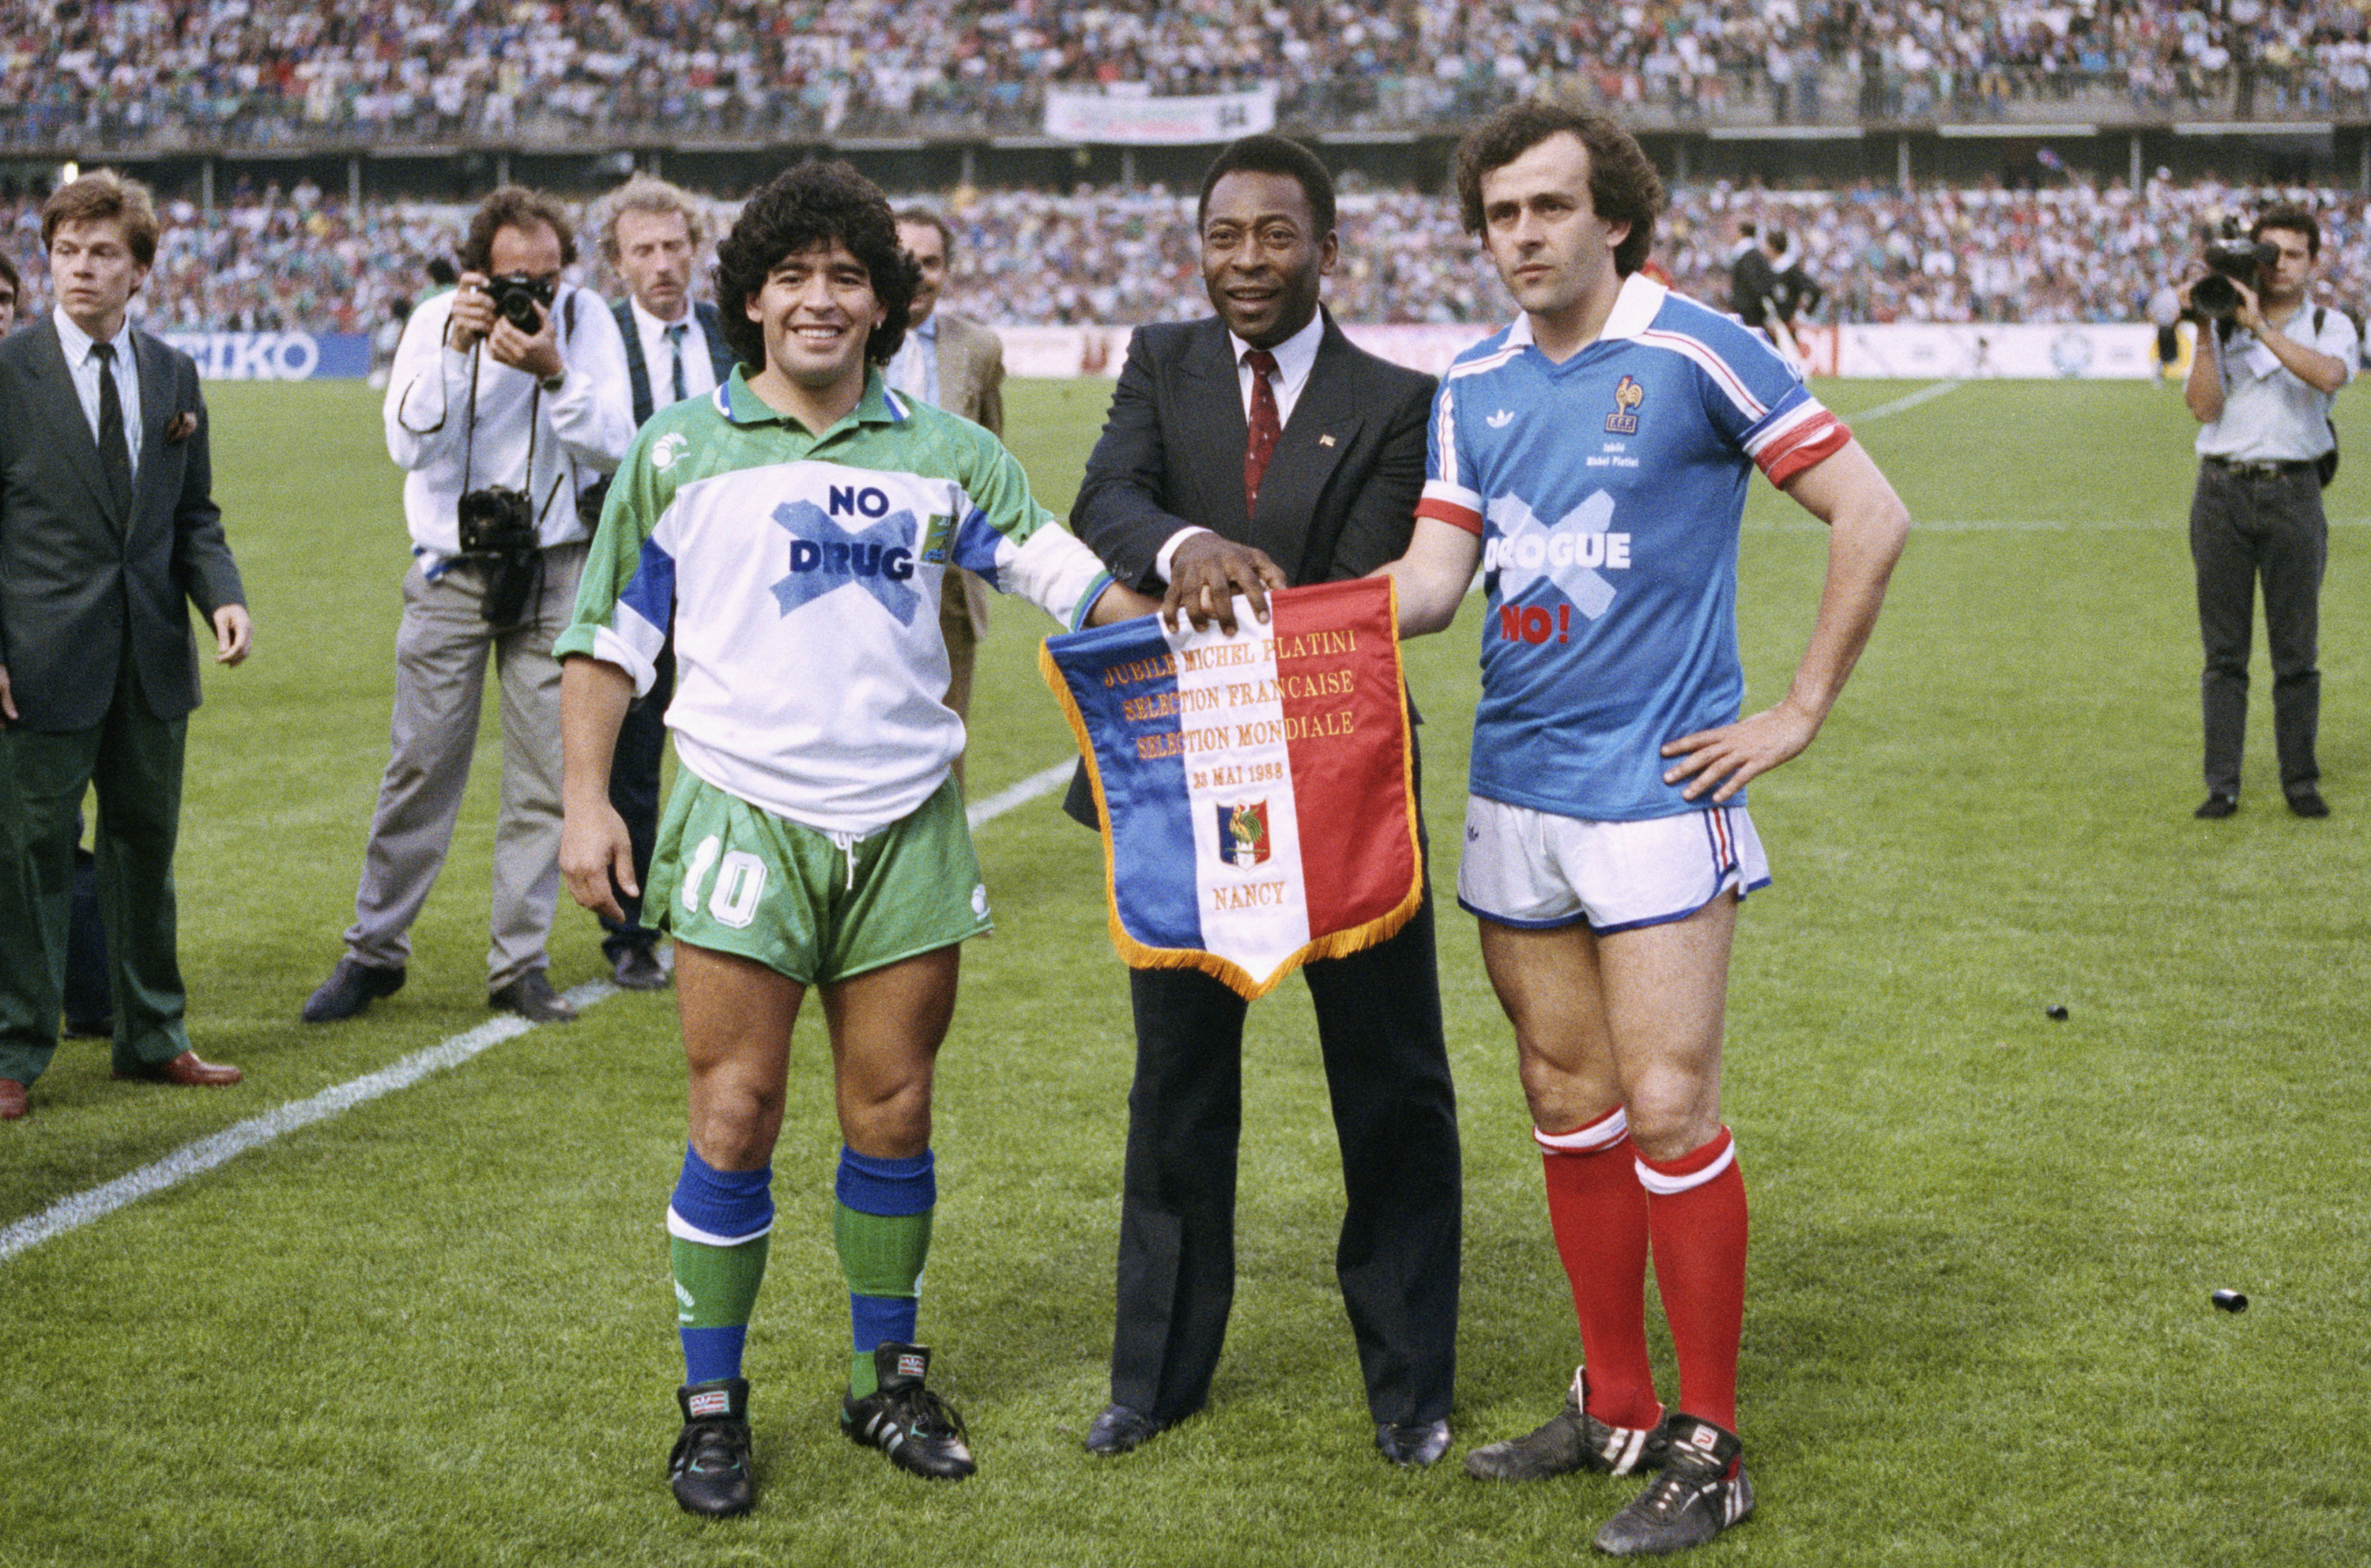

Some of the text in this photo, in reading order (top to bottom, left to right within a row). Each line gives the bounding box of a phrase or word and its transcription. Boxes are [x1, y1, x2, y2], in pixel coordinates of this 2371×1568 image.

[163, 331, 319, 381] EIKO
[829, 484, 890, 518] NO
[790, 540, 914, 581] DRUG
[1103, 630, 1357, 688] JUBILE MICHEL PLATINI
[1122, 670, 1355, 722] SELECTION FRANCAISE
[1136, 711, 1354, 760] SELECTION MONDIALE
[1212, 765, 1243, 786] MAI
[1248, 761, 1284, 782] 1988
[681, 835, 768, 929] 10
[1212, 880, 1285, 910] NANCY
